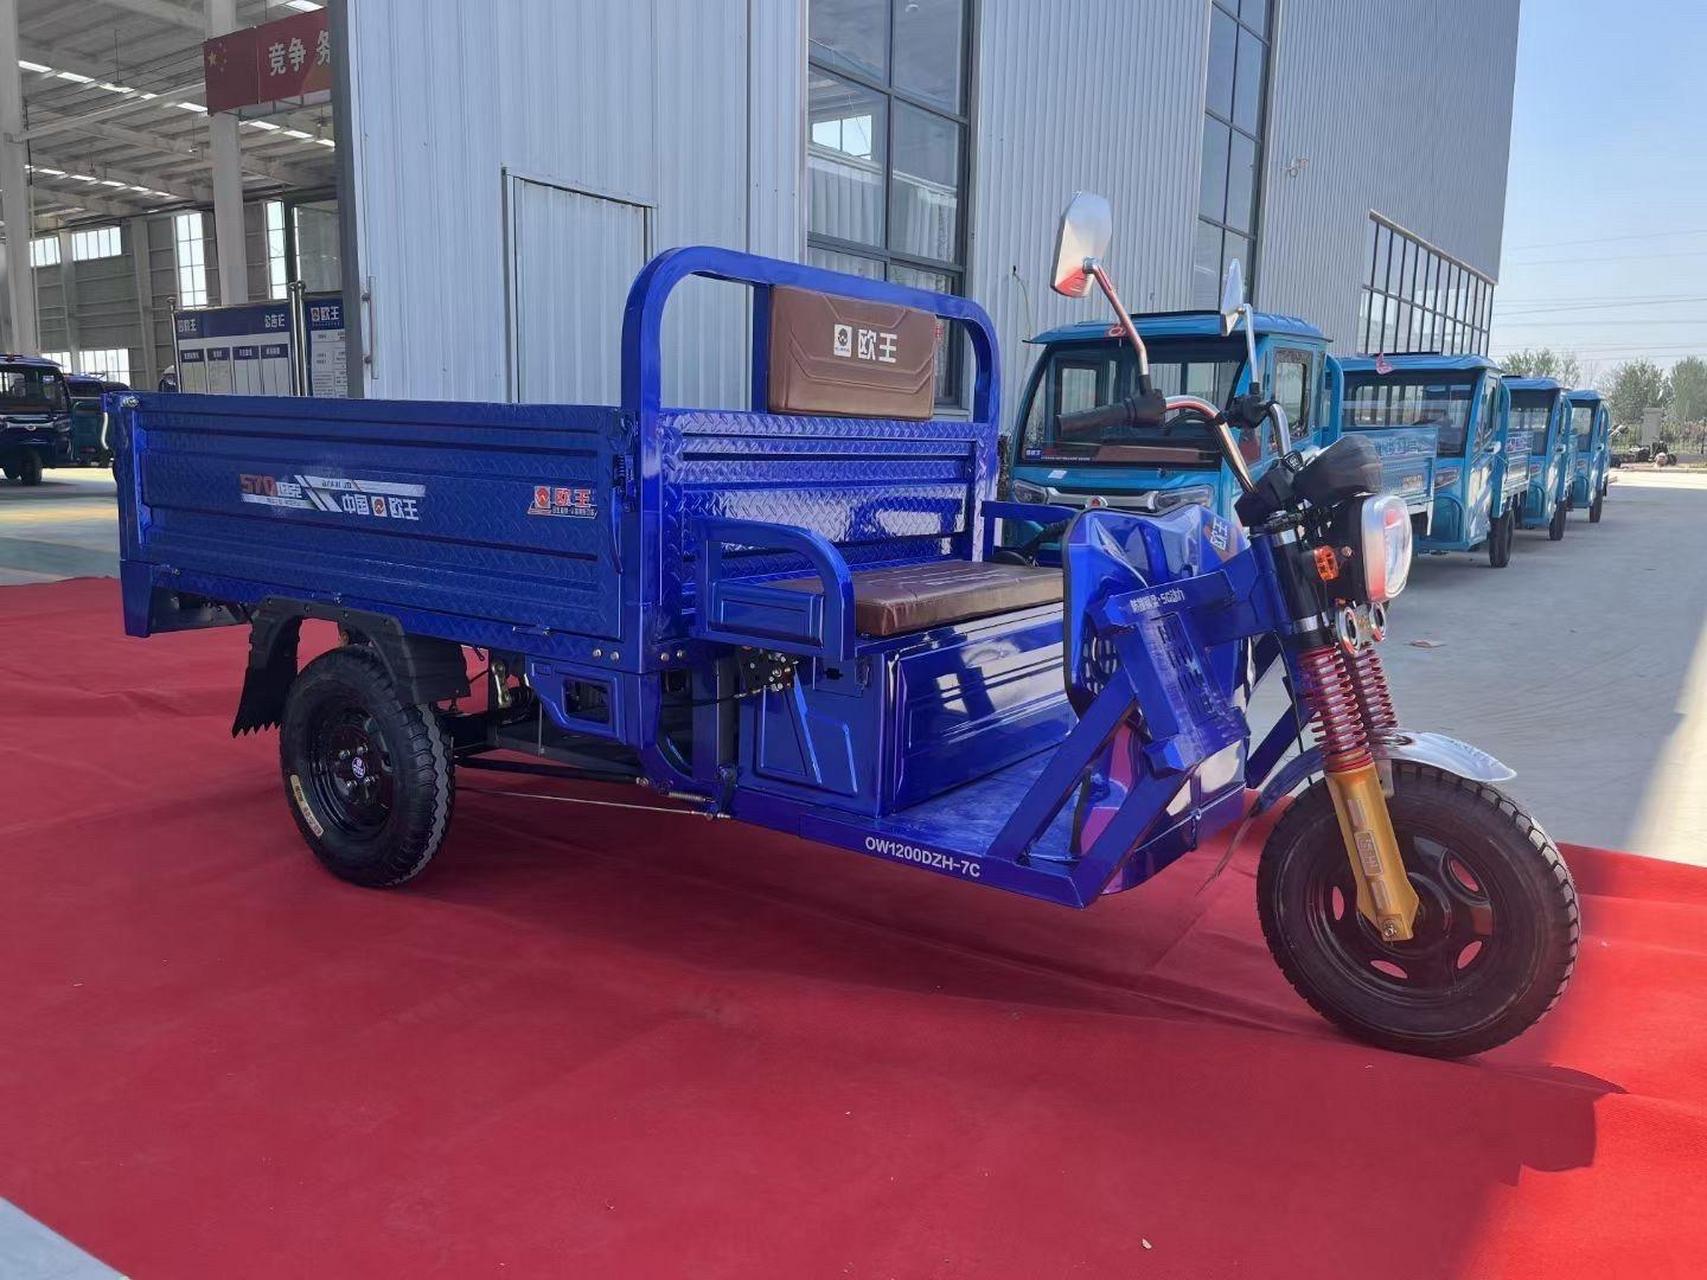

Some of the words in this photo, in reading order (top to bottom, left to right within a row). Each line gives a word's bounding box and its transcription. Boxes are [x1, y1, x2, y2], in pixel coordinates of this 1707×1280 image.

[268, 37, 307, 76] 竞争
[858, 328, 898, 363] 欧王
[341, 493, 370, 516] 中国
[388, 496, 419, 521] 欧王
[554, 487, 592, 508] 欧王
[865, 836, 981, 878] OW1200DZH-7C
